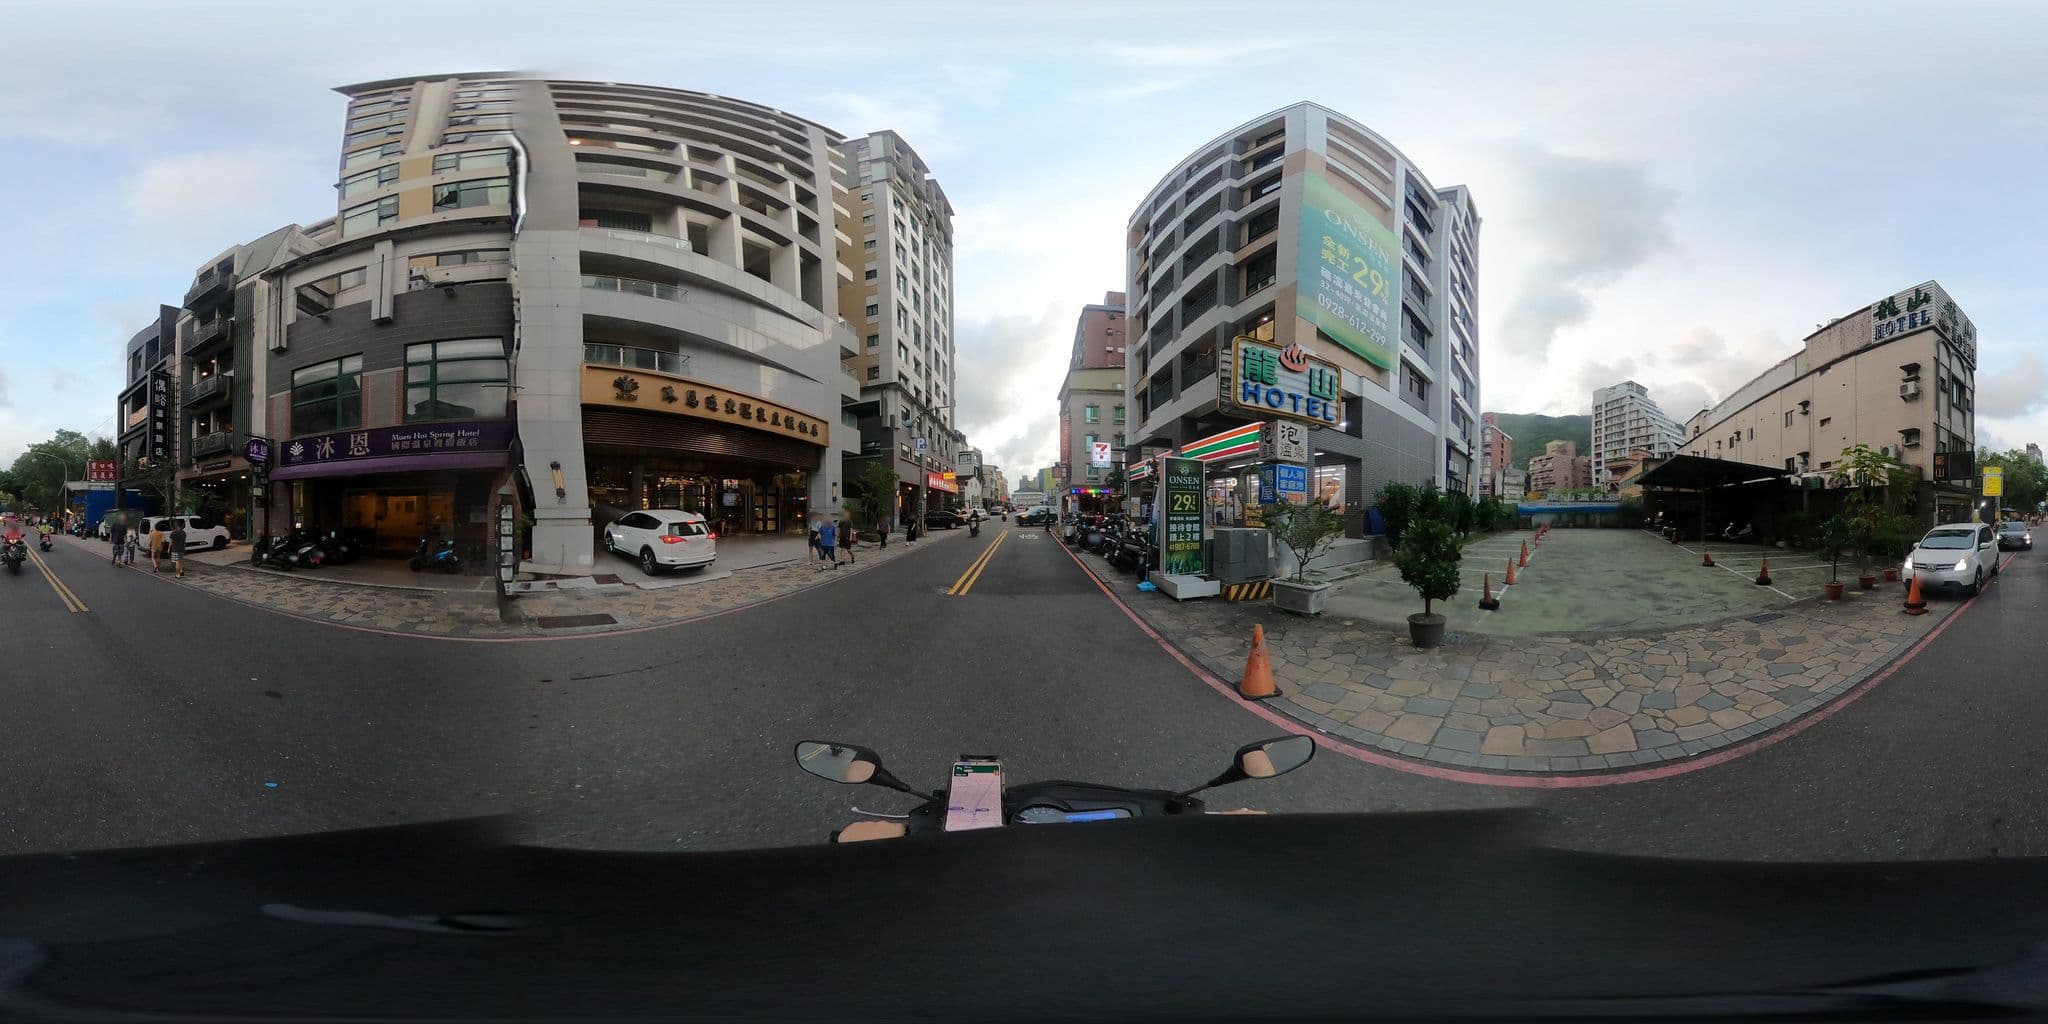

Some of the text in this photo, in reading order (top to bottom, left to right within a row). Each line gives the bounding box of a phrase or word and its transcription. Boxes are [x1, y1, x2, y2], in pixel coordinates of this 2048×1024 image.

[1317, 292, 1386, 347] 0928-612-299
[1874, 309, 1931, 341] HOTEL
[1243, 345, 1338, 400] 龍山
[1242, 382, 1336, 421] HOTEL
[316, 432, 371, 460] 沐恩
[413, 432, 428, 440] Hot
[429, 430, 455, 441] Spring
[457, 428, 480, 438] Hotel
[1280, 425, 1300, 445] 泡
[1280, 443, 1305, 459] 溫泉
[1169, 475, 1200, 484] ONSEN
[1173, 494, 1192, 511] 29
